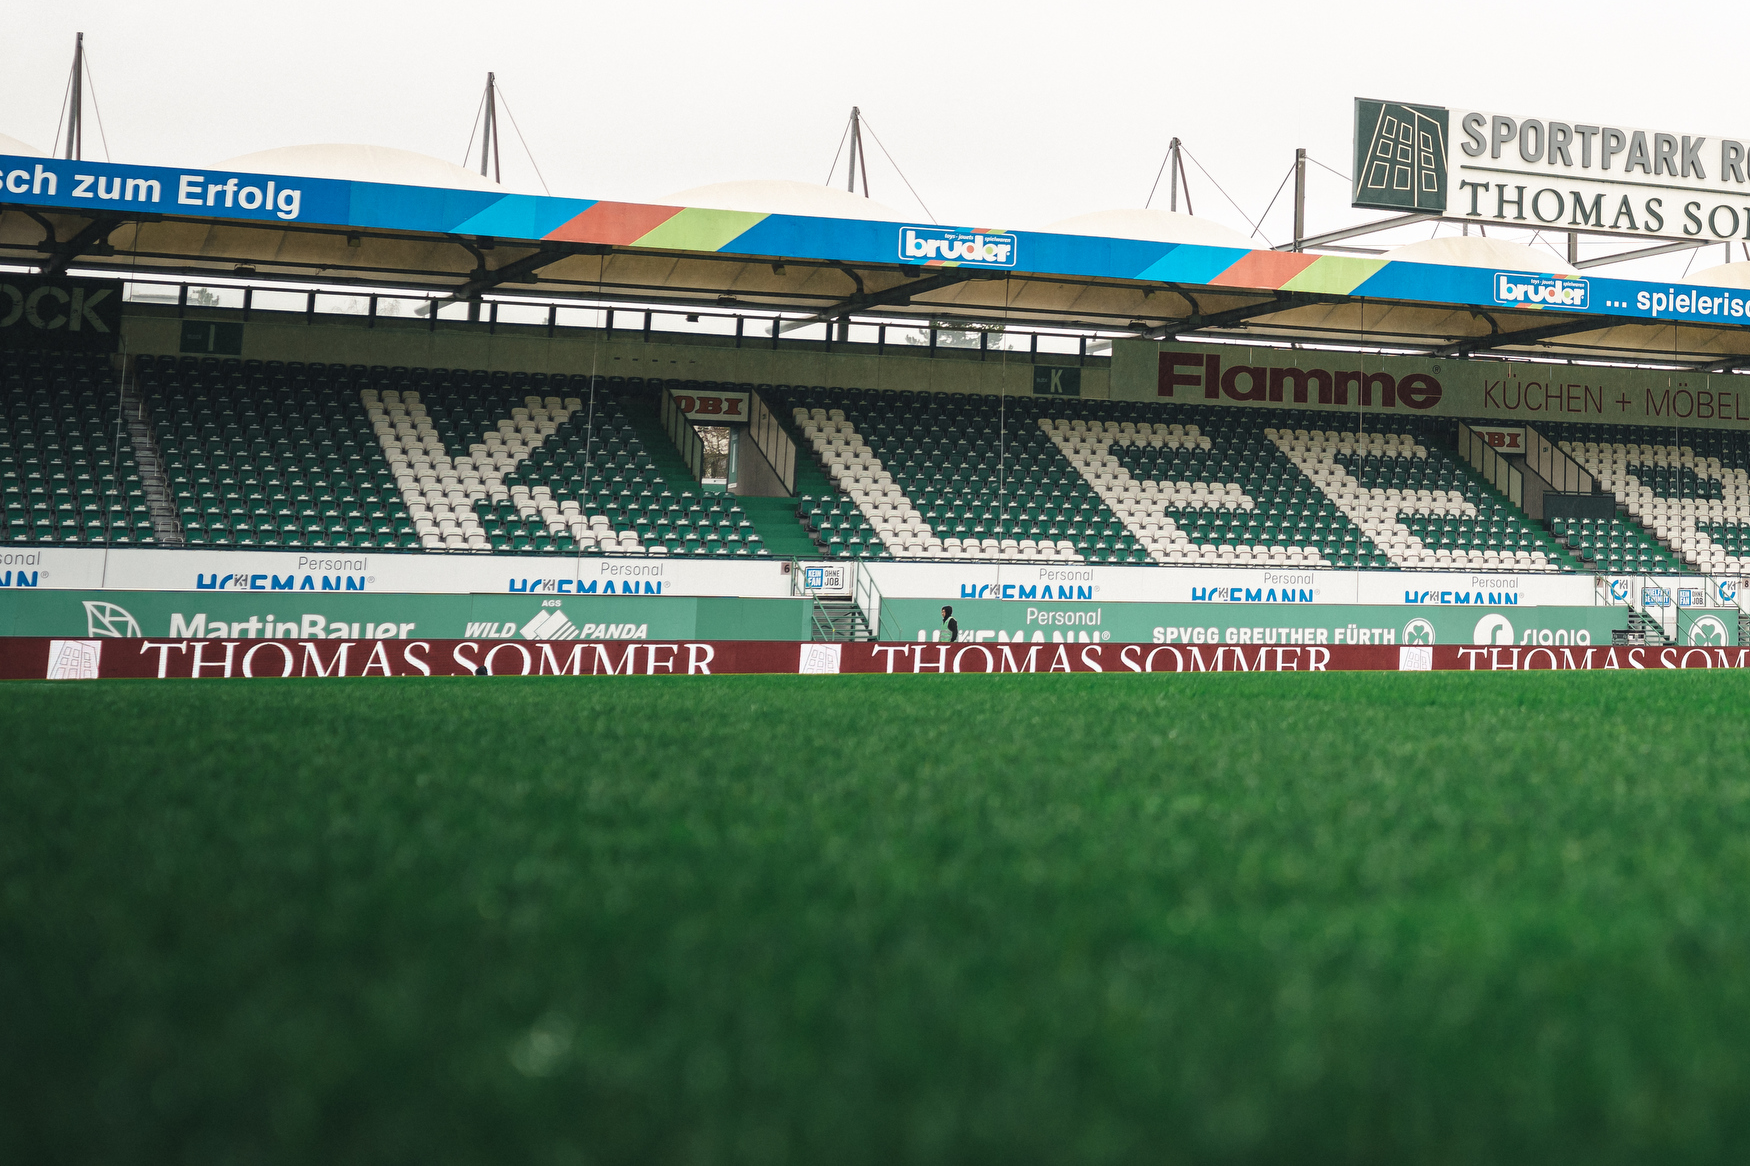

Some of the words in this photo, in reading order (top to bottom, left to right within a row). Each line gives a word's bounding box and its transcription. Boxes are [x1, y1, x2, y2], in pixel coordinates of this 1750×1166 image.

[1460, 111, 1708, 180] SPORTPARK
[71, 174, 161, 203] zum
[177, 174, 302, 220] Erfolg
[1459, 179, 1666, 233] THOMAS
[905, 230, 1012, 263] bruder
[1499, 275, 1585, 306] bruder
[1050, 369, 1063, 393] K
[1157, 351, 1443, 410] Flamme
[1483, 372, 1603, 414] KÜCHEN
[1645, 382, 1750, 421] MÖBEL
[297, 556, 368, 571] Personal
[600, 561, 664, 576] Personal
[783, 564, 791, 573] 6
[824, 569, 840, 578] OHNE
[1039, 568, 1094, 581] Personal
[1263, 572, 1315, 585] Personal
[1472, 576, 1519, 589] Personal
[1744, 580, 1749, 588] 8
[541, 599, 562, 608] AGS
[169, 613, 416, 639] MartinBauer
[1026, 607, 1102, 626] Personal
[464, 622, 516, 638] WILD
[579, 623, 648, 639] PANDA
[1152, 626, 1219, 644] SPVGG
[1225, 627, 1328, 645] GREUTHER
[1334, 623, 1396, 645] FÜRTH
[140, 640, 430, 679] THOMAS
[452, 642, 715, 677] SOMMER
[872, 643, 1103, 673] THOMAS
[1121, 644, 1331, 672] SOMMER
[1457, 647, 1647, 670] THOMAS
